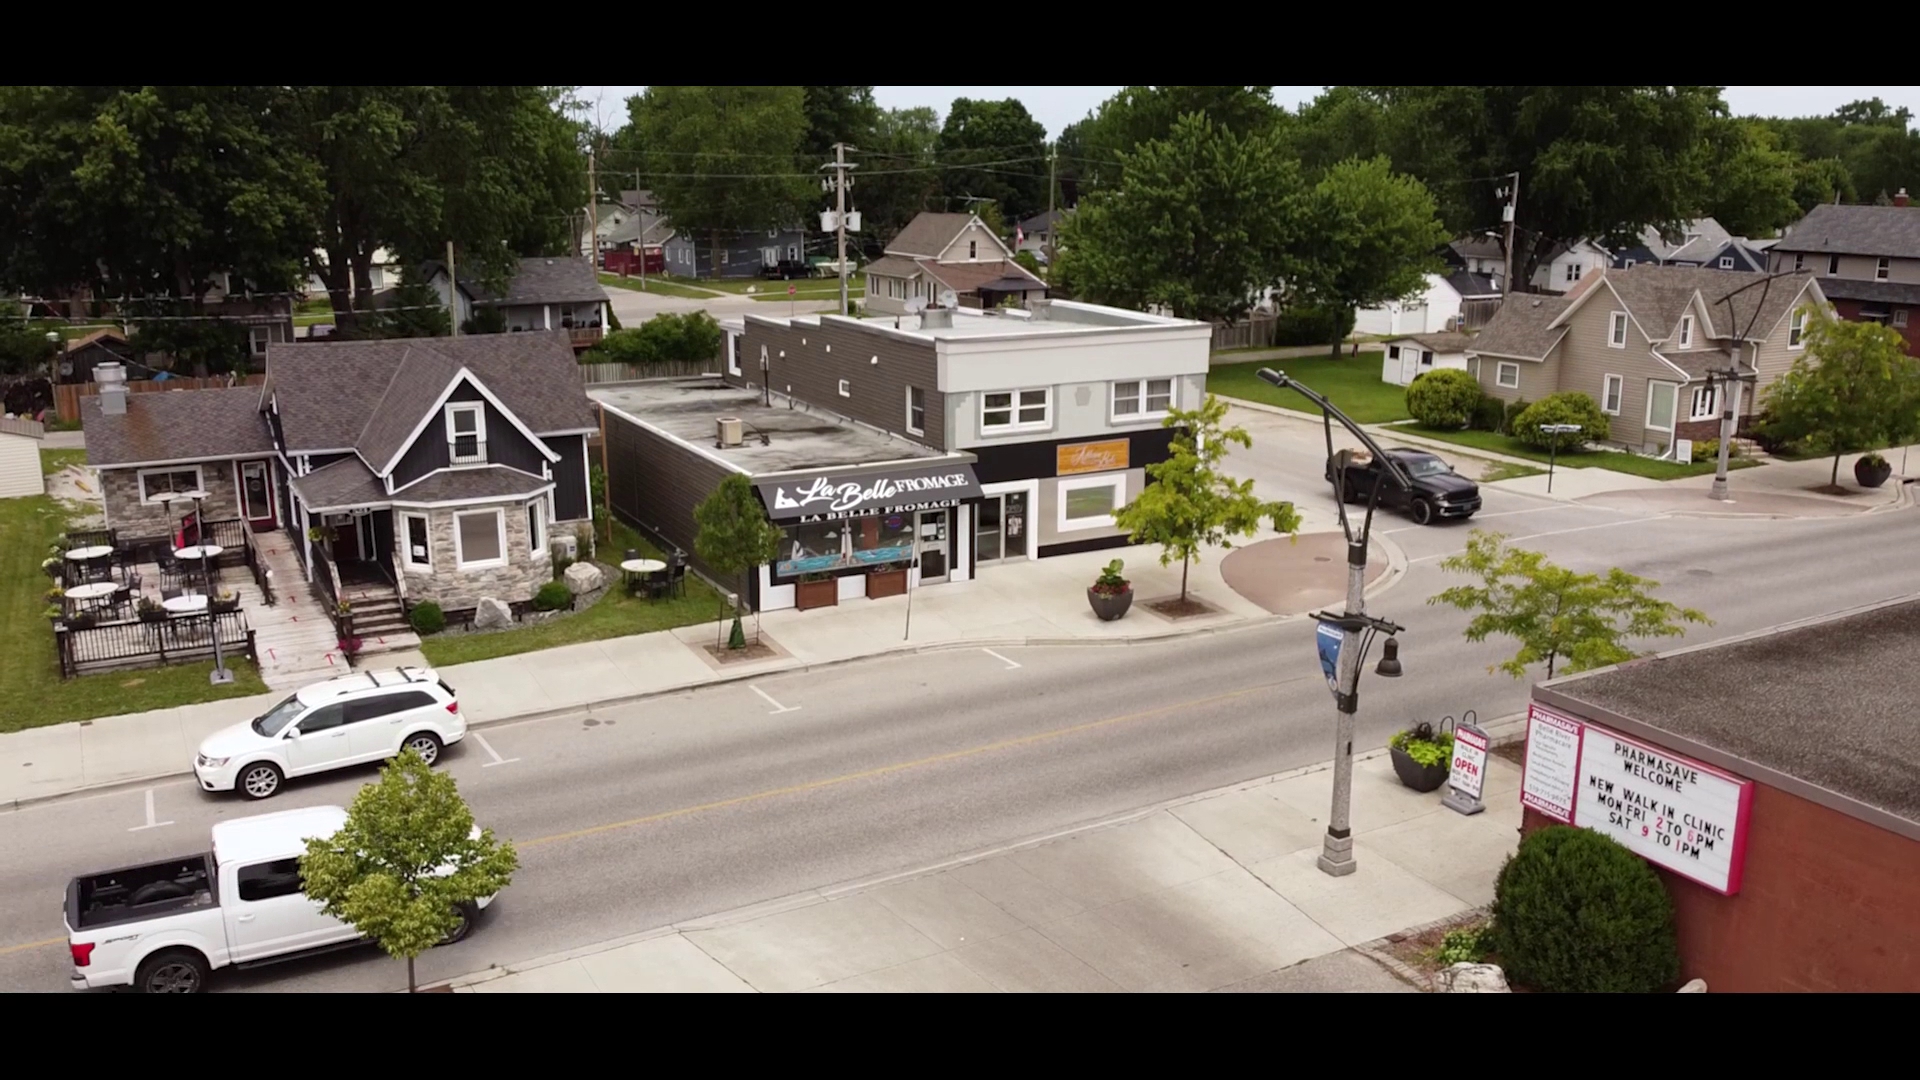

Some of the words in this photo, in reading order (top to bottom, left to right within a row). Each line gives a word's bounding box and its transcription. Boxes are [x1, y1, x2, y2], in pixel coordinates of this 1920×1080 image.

[796, 477, 836, 507] La
[830, 479, 897, 511] Belle
[894, 473, 969, 493] FROMAGE
[801, 515, 821, 523] LA
[827, 507, 880, 520] BELLE
[885, 499, 961, 514] FROMAGE
[1532, 710, 1579, 735] PHARMASAVE
[1555, 728, 1571, 741] River
[1454, 757, 1479, 776] OPEN
[1614, 742, 1698, 784] PHARMASAVE
[1624, 760, 1683, 793] WELCOME
[1524, 792, 1570, 819] PHARMASAVE
[1590, 775, 1614, 794] NEW
[1623, 788, 1658, 812] WALK
[1662, 804, 1675, 819] IN
[1683, 813, 1725, 840] CLINIC
[1597, 792, 1622, 812] MON
[1626, 804, 1646, 822] FRI
[1656, 816, 1663, 829] 2
[1666, 820, 1682, 836] TO
[1609, 811, 1632, 829] SAT
[1641, 825, 1649, 836] 9
[1656, 831, 1671, 846] TO
